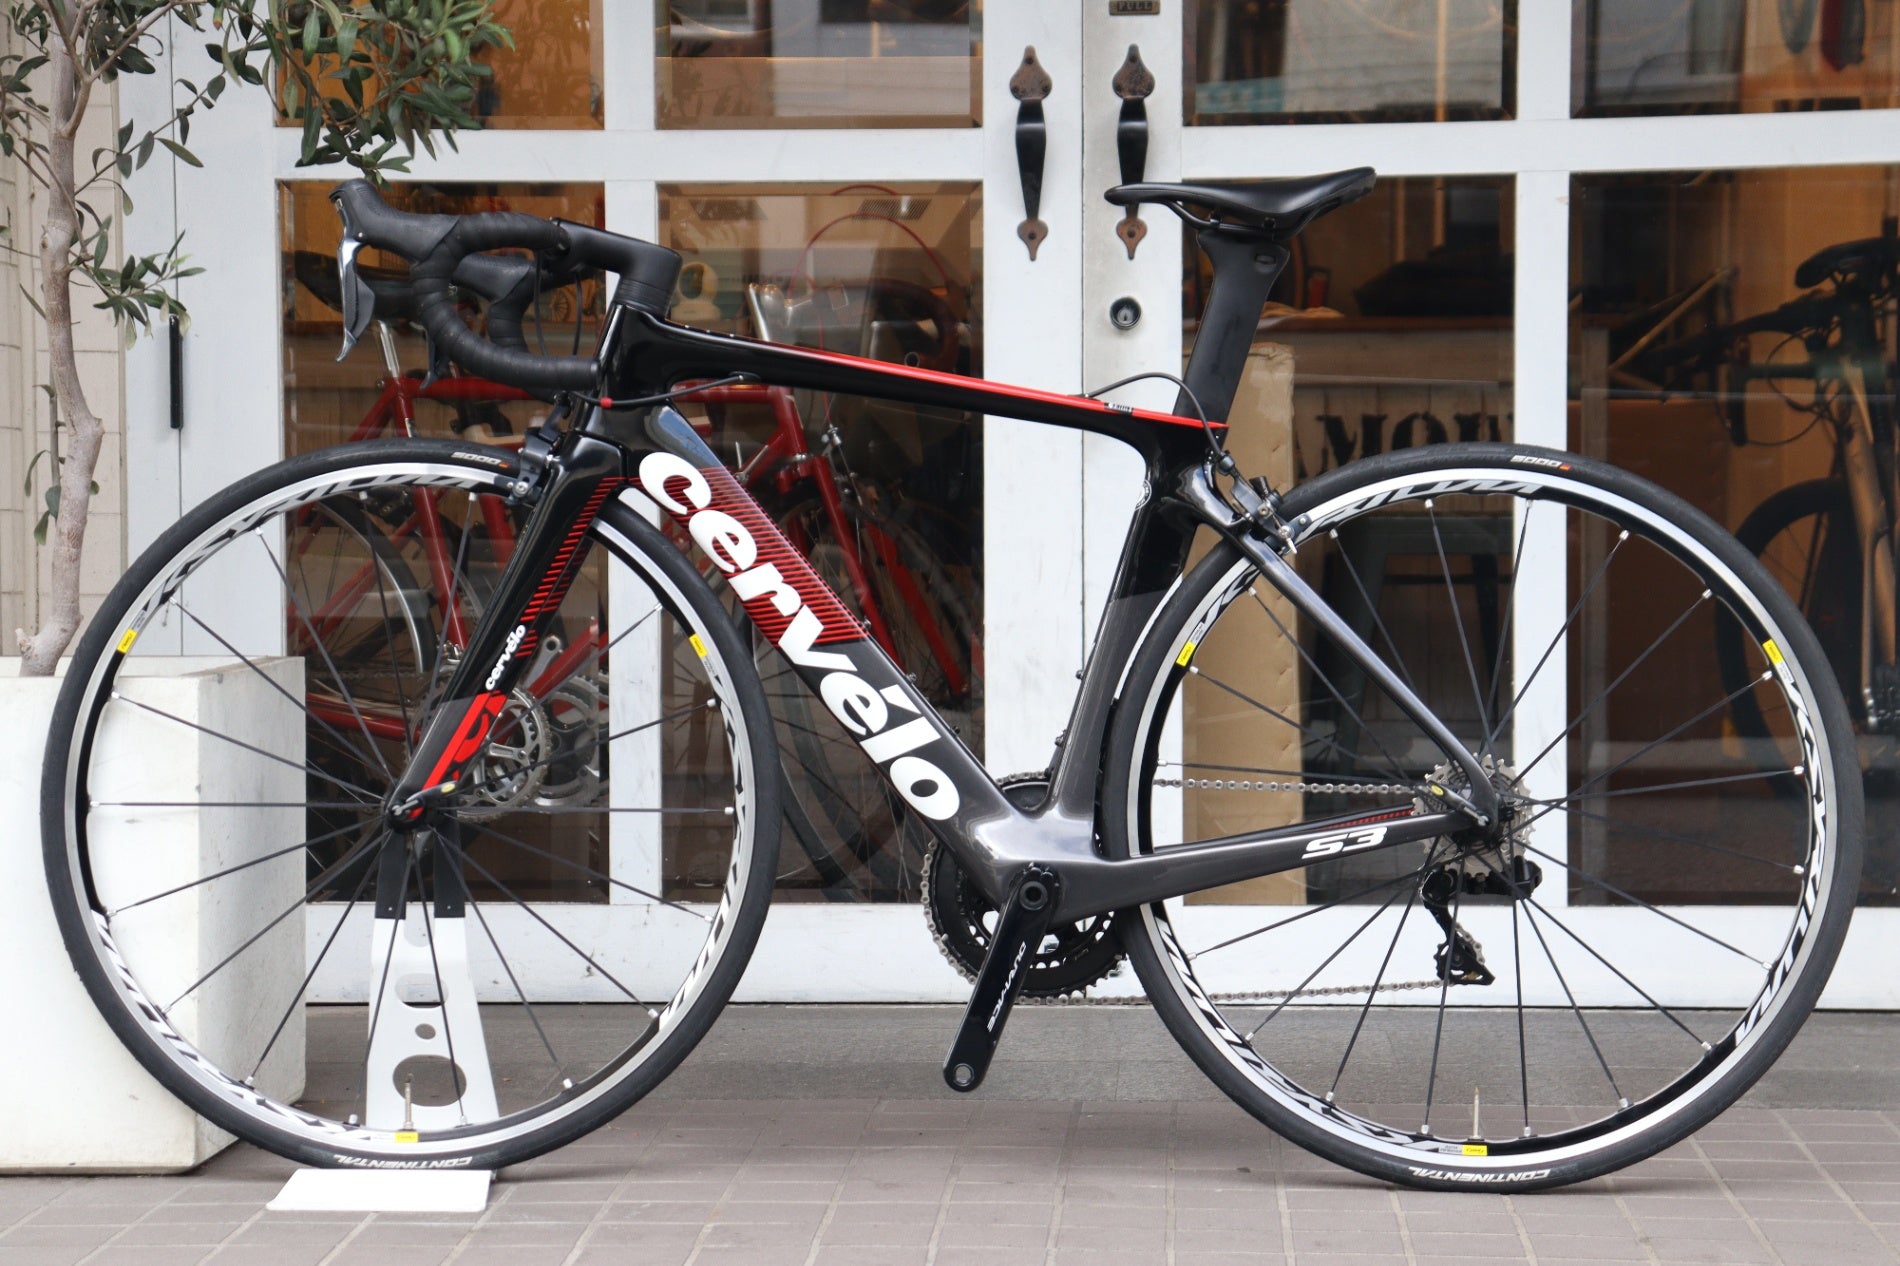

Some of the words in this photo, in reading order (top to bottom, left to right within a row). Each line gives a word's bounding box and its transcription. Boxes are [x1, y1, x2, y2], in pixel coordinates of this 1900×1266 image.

[1118, 1, 1153, 11] PULL
[639, 452, 960, 820] cervélo
[485, 625, 525, 690] cervélo
[1301, 826, 1387, 859] S3
[333, 1154, 472, 1168] CONTINENTAL
[1408, 1166, 1550, 1183] CONTINENTAL
